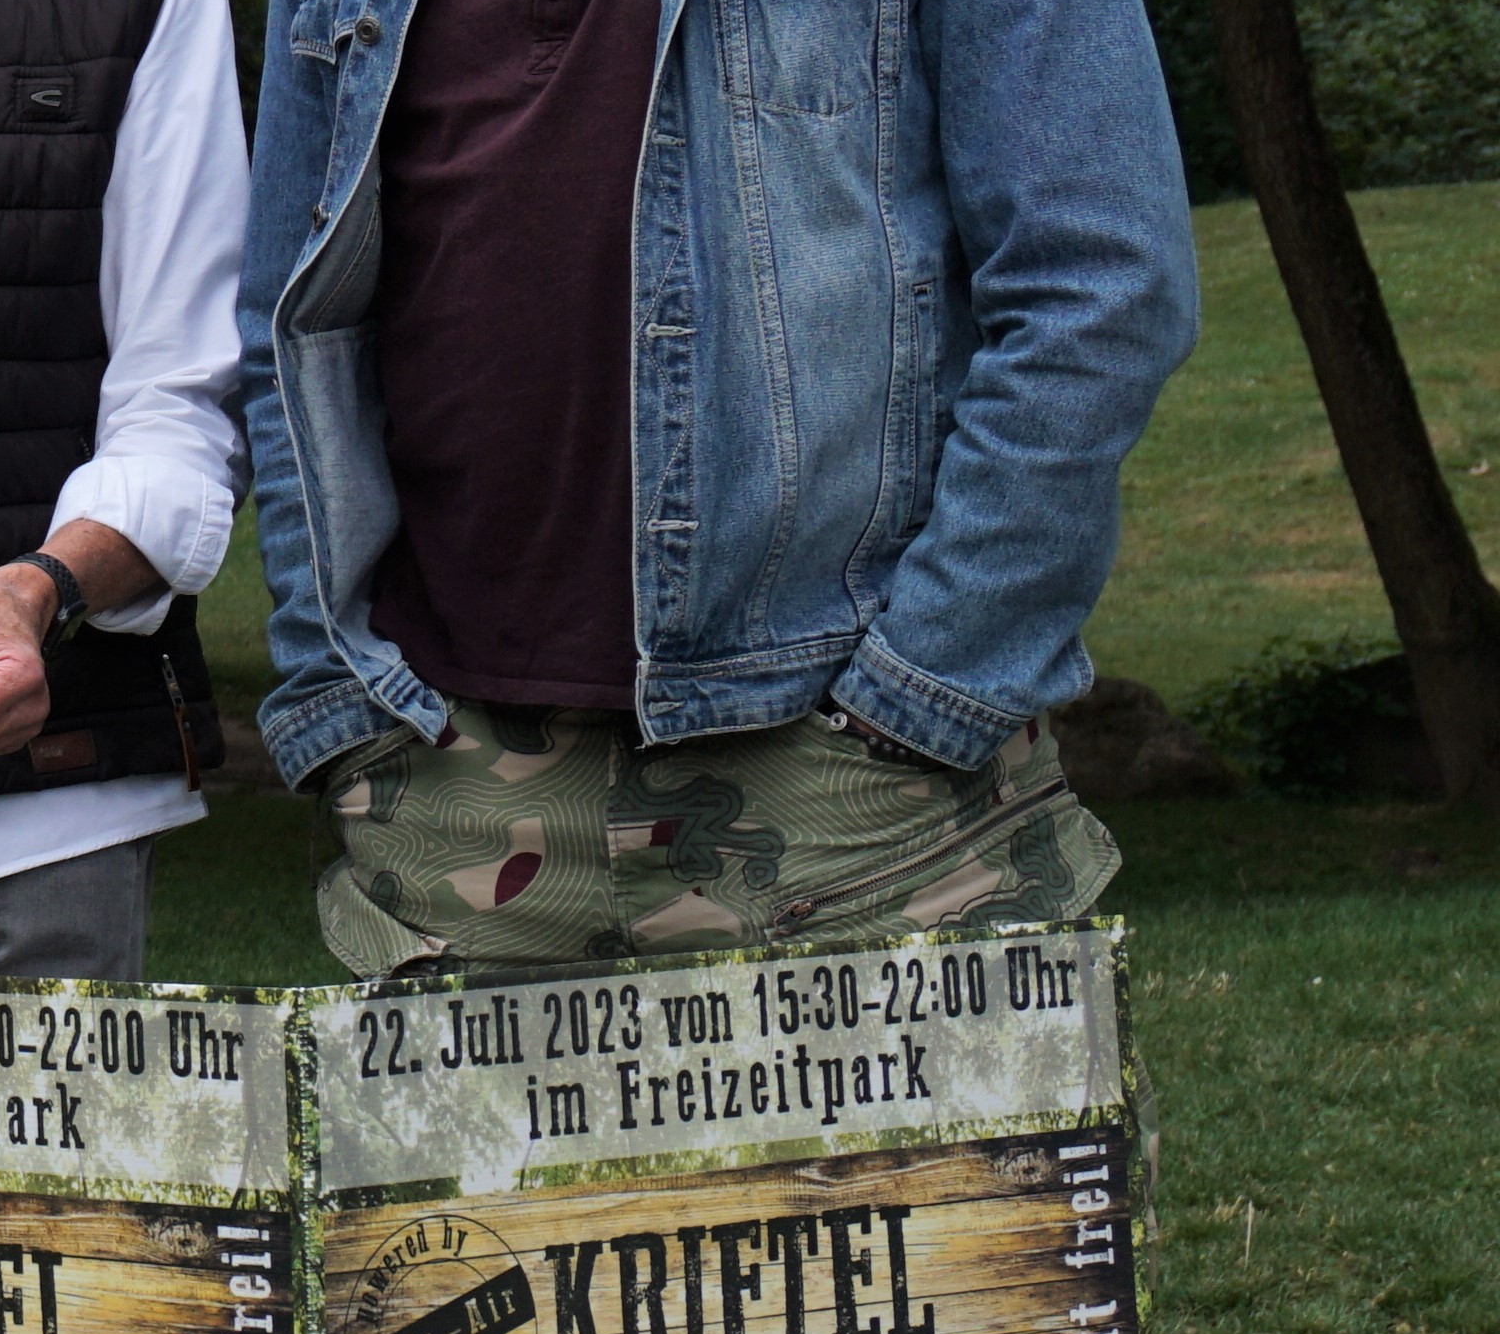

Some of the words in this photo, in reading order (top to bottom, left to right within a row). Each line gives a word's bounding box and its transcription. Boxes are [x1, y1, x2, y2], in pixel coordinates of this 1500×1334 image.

[166, 1010, 245, 1082] Uhr
[358, 1008, 422, 1077] 22.
[440, 993, 524, 1069] Juli
[543, 984, 643, 1058] 2023
[660, 989, 733, 1047] von
[1004, 944, 1079, 1012] Uhr
[526, 1074, 589, 1139] im
[616, 1032, 931, 1130] Freizeitpark
[1058, 1142, 1114, 1270] frei!
